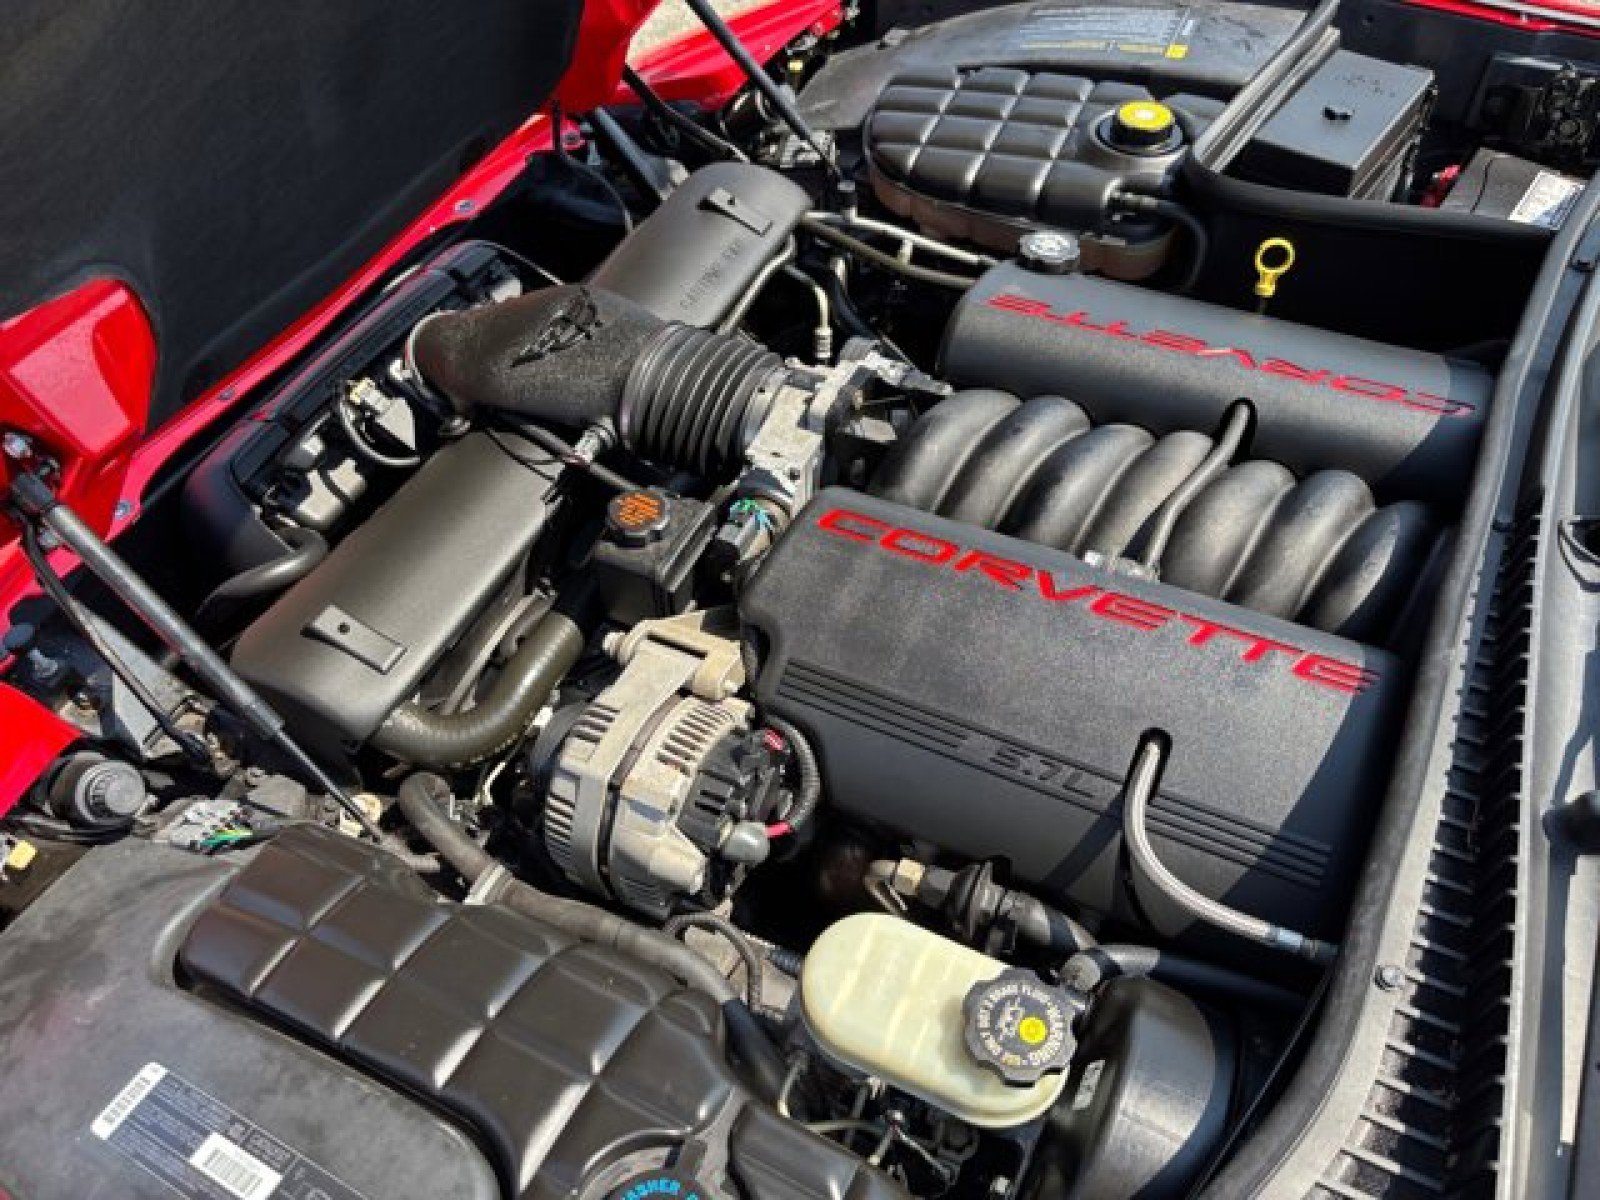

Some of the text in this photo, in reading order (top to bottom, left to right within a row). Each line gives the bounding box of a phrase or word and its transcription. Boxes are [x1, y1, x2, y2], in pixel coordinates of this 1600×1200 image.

[987, 294, 1476, 416] CORVETTE
[816, 506, 1382, 696] CORVETTE
[989, 745, 1096, 799] 5.7L
